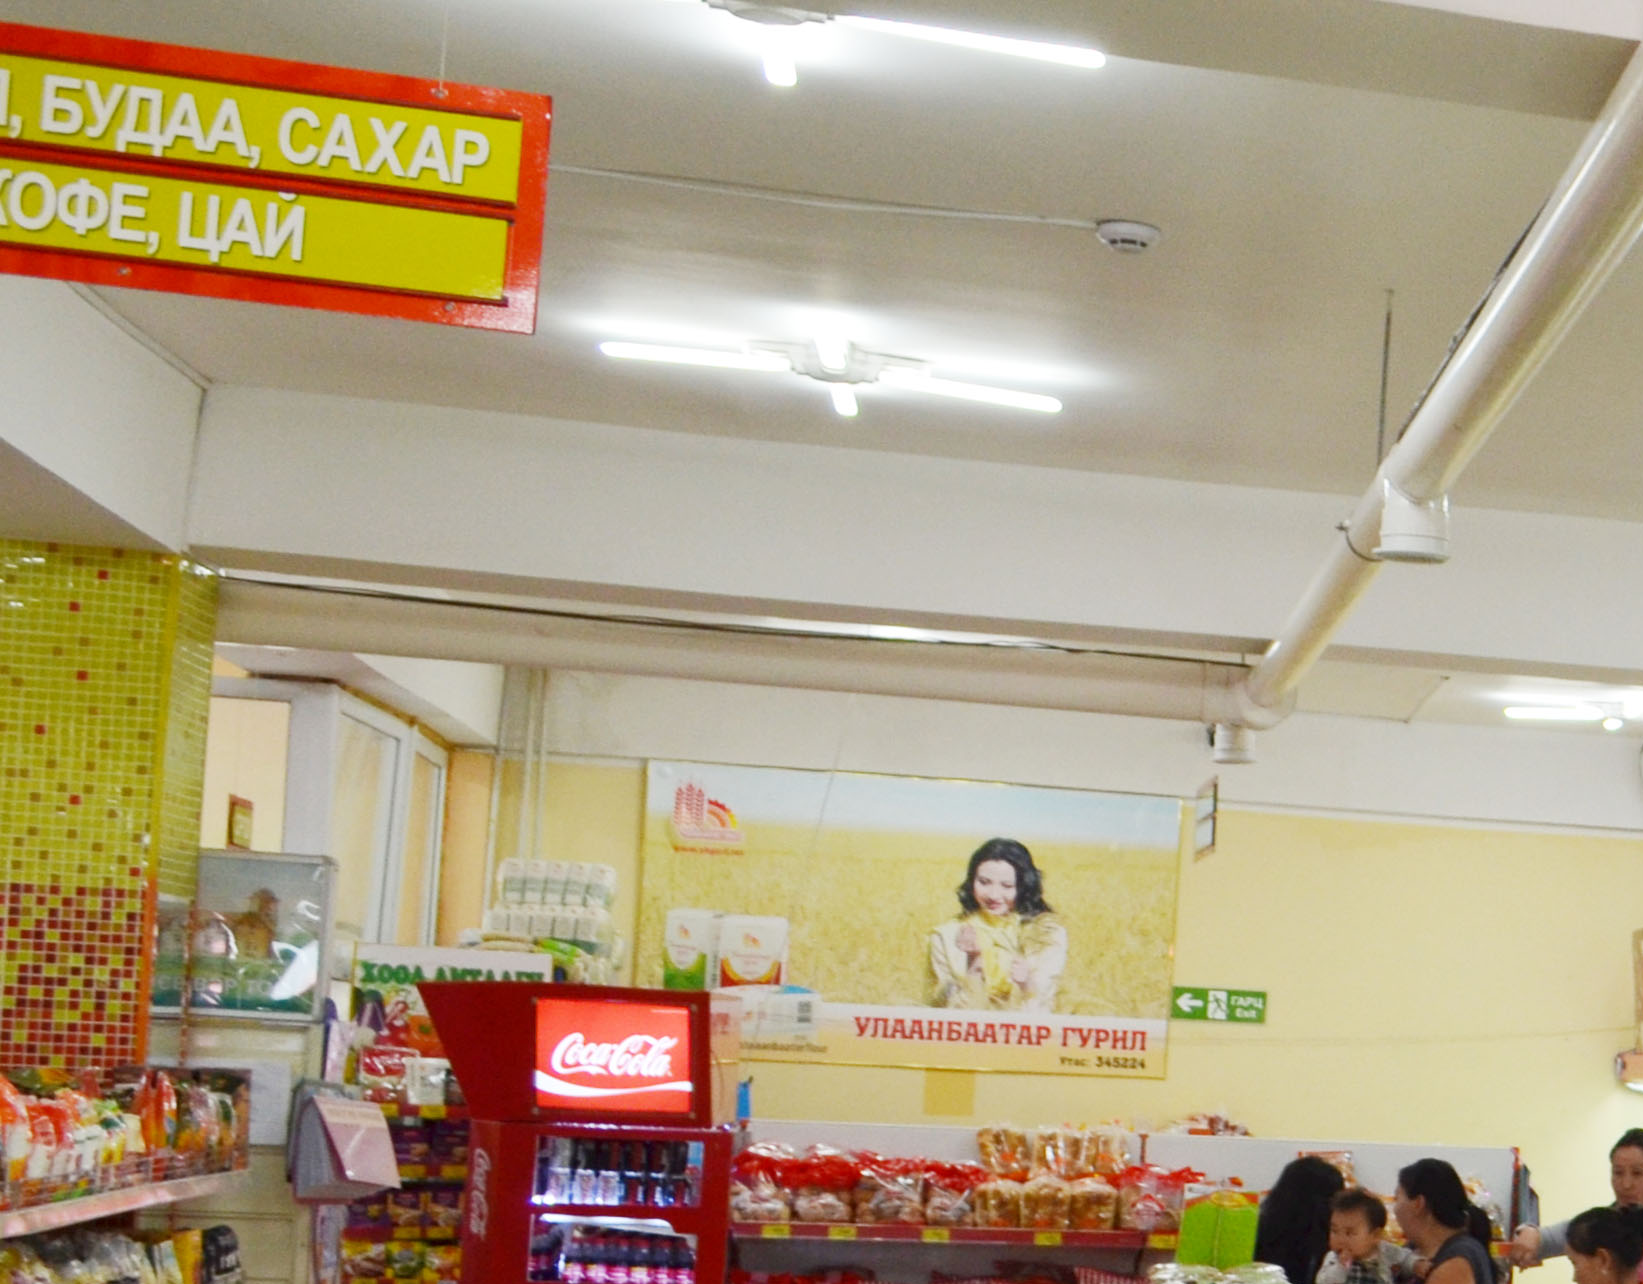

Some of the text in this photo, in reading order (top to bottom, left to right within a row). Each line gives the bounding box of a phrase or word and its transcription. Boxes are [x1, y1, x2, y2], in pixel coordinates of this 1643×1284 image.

[41, 74, 261, 169] БУДАА,
[279, 107, 491, 185] САХАР
[177, 190, 306, 263] ЦАЙ
[853, 1015, 1051, 1047] УЛААНБААТАР
